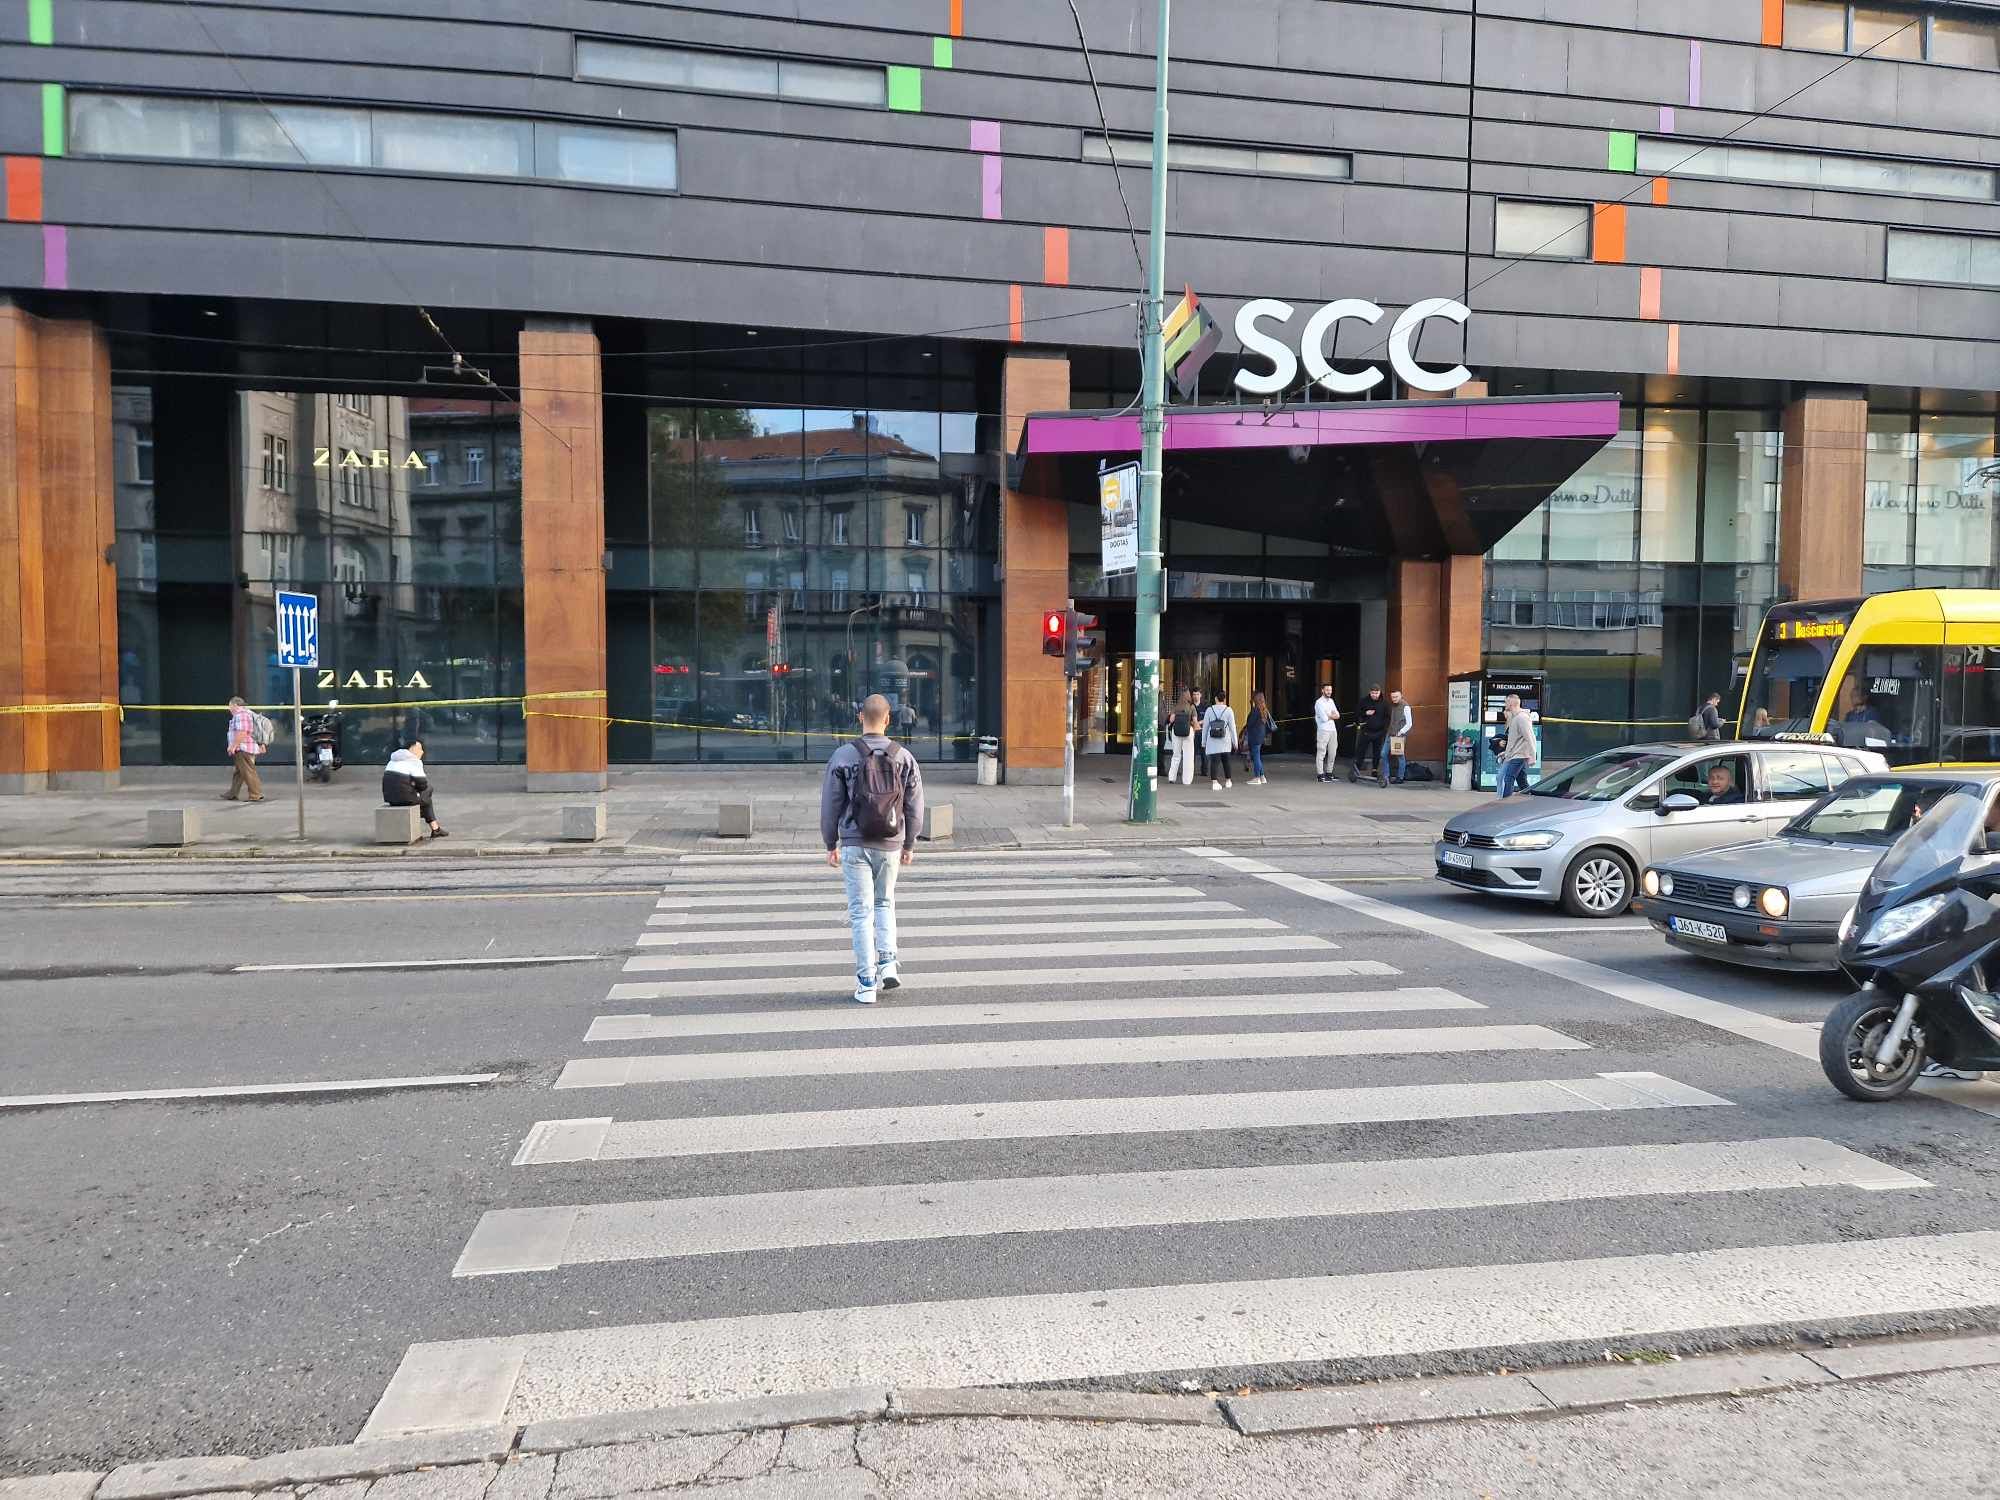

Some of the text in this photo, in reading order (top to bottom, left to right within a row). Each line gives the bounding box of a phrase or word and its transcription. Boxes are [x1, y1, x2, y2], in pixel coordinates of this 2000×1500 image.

[1234, 297, 1473, 393] SCC
[313, 447, 428, 468] ZARA
[1780, 622, 1787, 639] 3
[317, 669, 432, 688] ZARA
[1496, 683, 1533, 691] RECIKLOMAT
